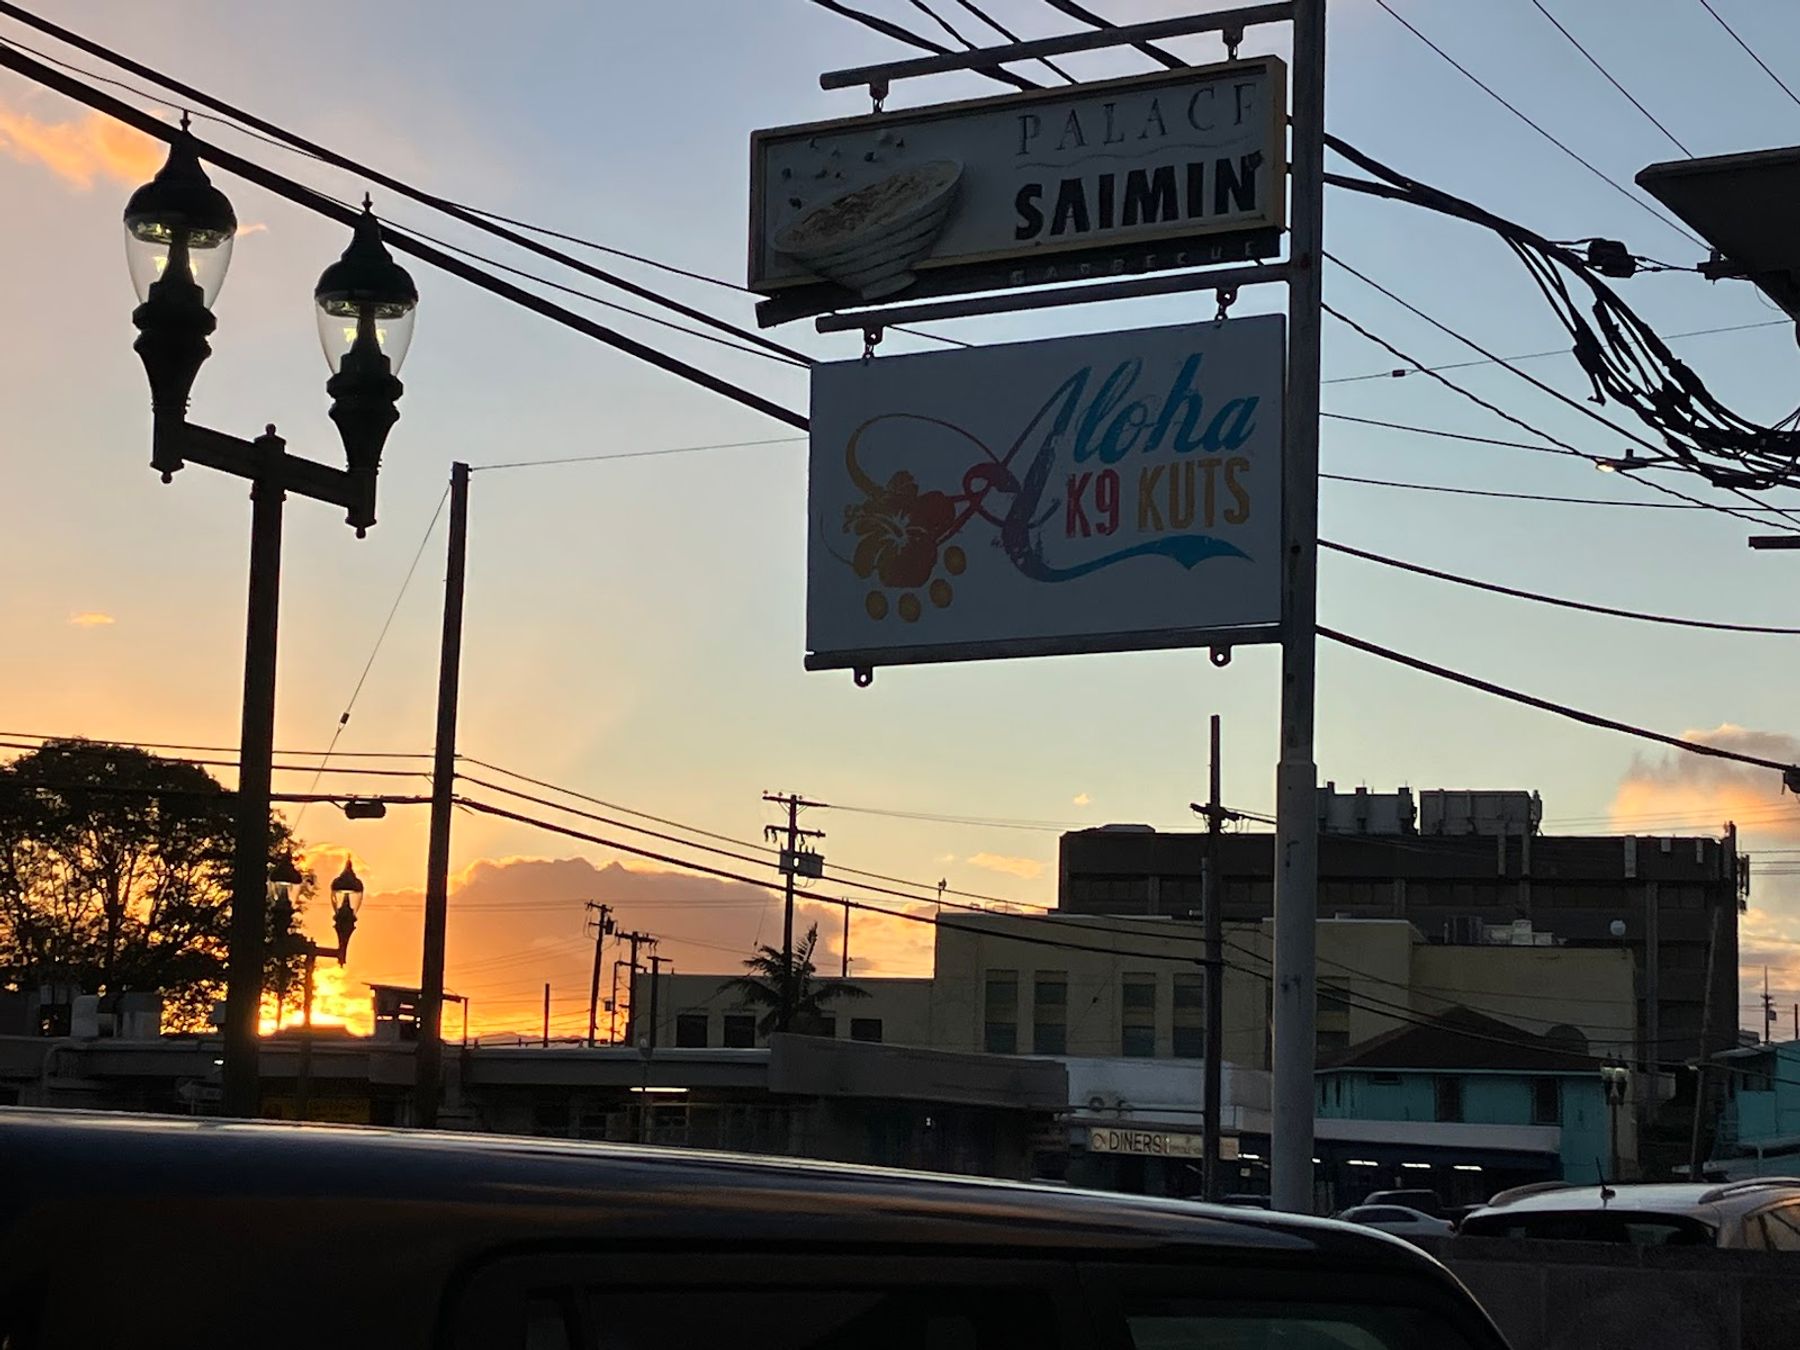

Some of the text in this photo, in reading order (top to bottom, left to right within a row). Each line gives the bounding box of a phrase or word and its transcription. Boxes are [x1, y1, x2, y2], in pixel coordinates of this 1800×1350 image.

[1015, 151, 1259, 240] SAIMIN
[1001, 352, 1261, 575] Aloha
[1066, 456, 1250, 537] K9 KUTS
